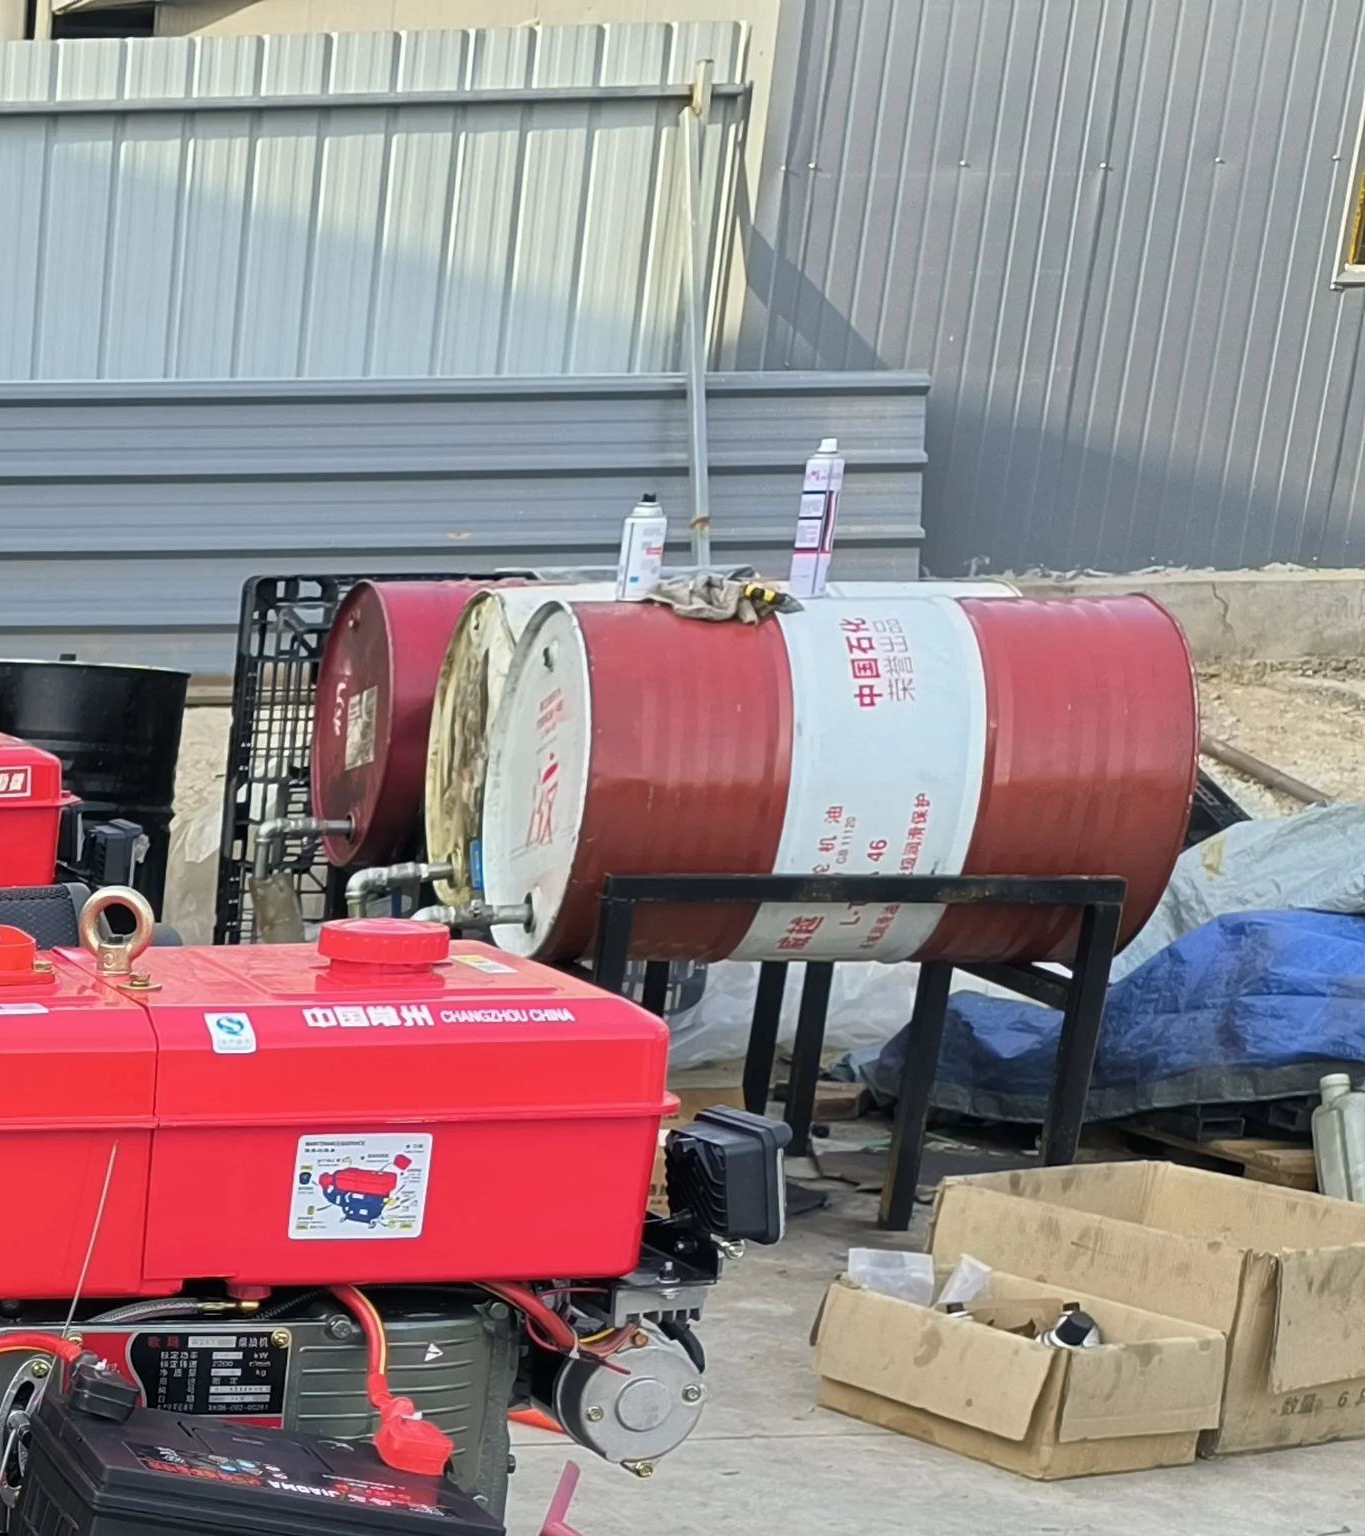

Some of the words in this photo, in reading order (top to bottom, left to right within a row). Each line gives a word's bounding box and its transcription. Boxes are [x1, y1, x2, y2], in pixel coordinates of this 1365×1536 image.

[839, 618, 884, 707] 中国石化
[872, 619, 917, 702] 荣誉出品
[867, 839, 888, 863] 46
[302, 1005, 435, 1028] 中国常州
[440, 1008, 529, 1024] CHANGZHOU
[529, 1008, 576, 1023] CHINA
[1337, 1391, 1350, 1408] 6
